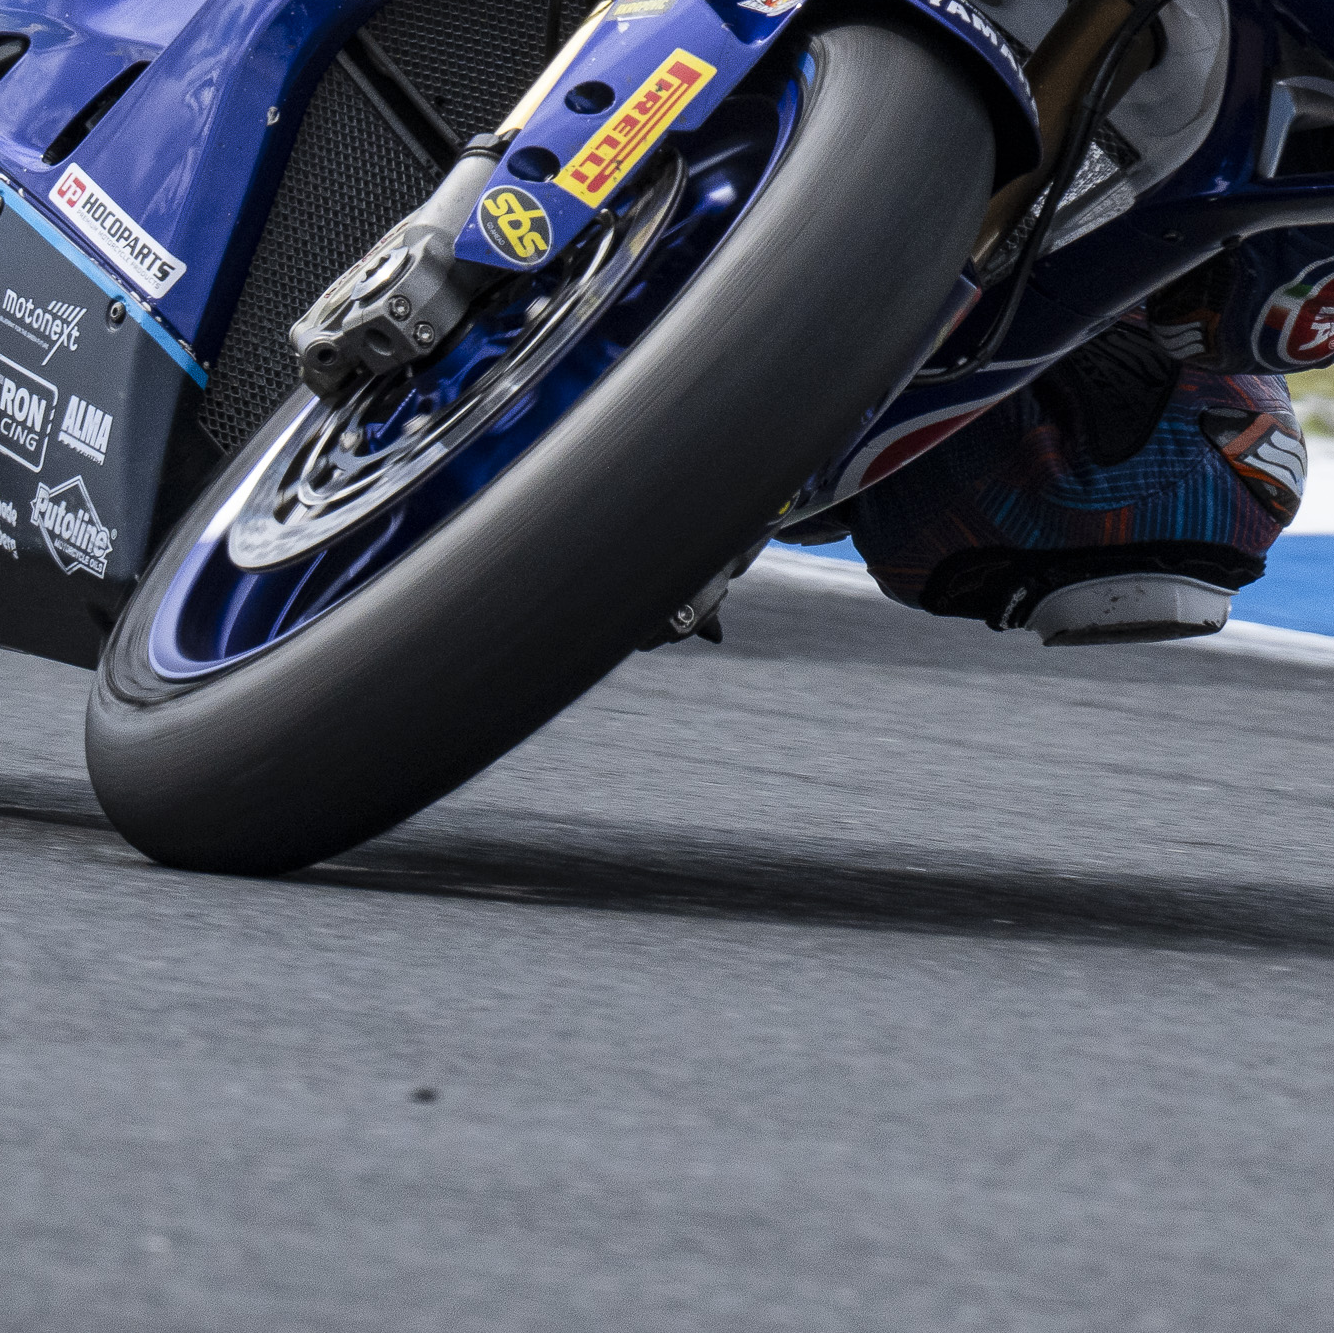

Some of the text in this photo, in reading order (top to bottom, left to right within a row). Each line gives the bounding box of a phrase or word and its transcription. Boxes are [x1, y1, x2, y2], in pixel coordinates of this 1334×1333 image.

[570, 60, 703, 194] PIRELLI
[81, 192, 176, 282] HOCOPARTS
[2, 288, 87, 365] motonext
[61, 394, 113, 453] ALMA
[33, 486, 110, 559] Putoline
